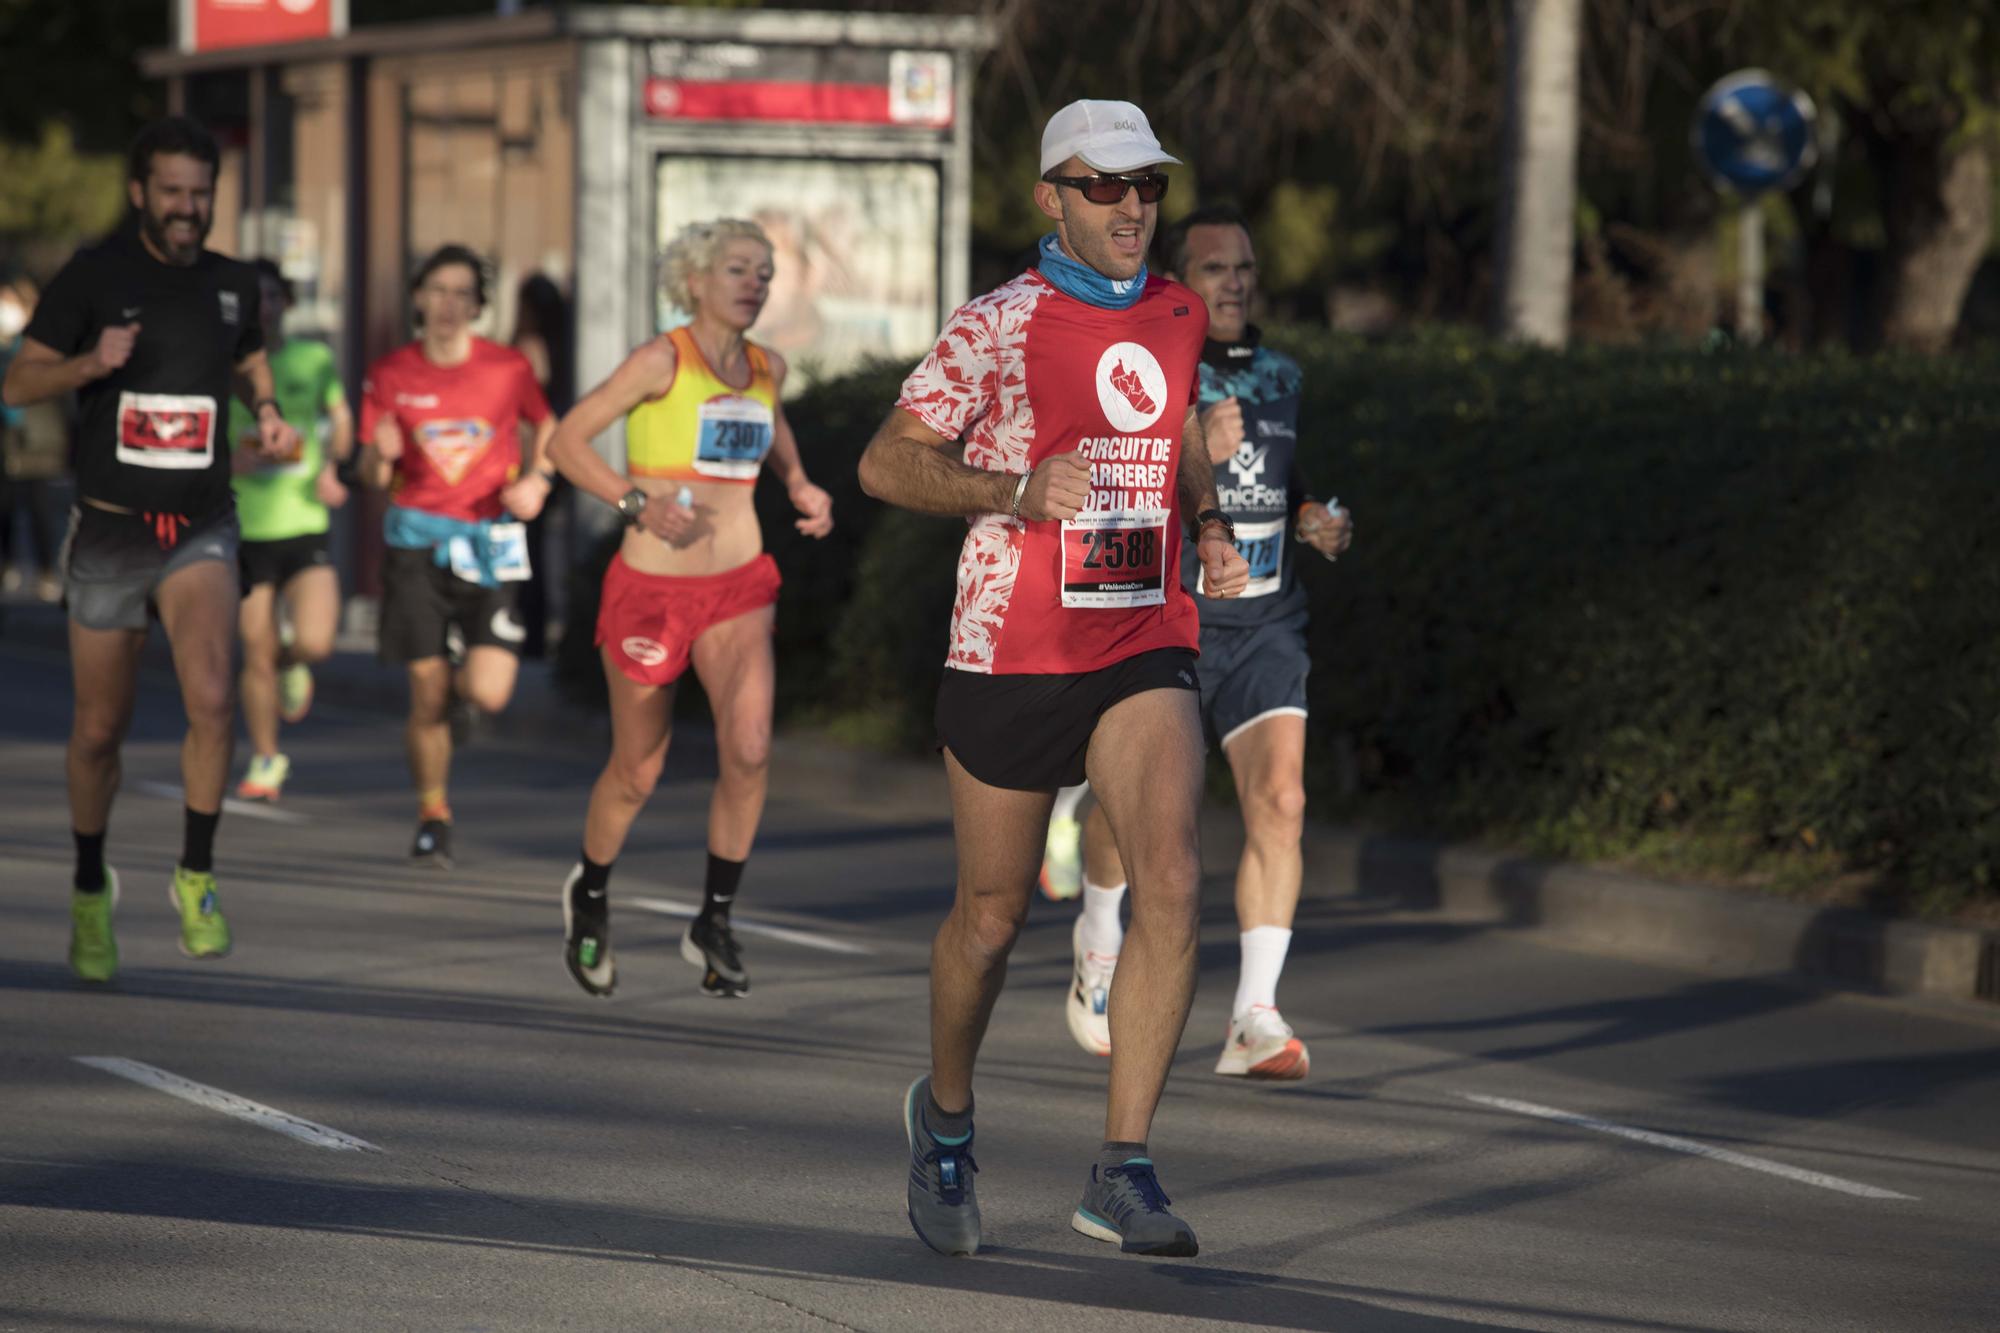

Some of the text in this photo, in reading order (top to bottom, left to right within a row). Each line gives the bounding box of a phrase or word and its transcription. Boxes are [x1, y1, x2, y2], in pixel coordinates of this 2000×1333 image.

[714, 420, 763, 450] 2301
[1077, 436, 1172, 462] CIRCUIT DE
[1088, 462, 1167, 488] ARRERES
[1082, 489, 1163, 512] OPULARS
[1081, 529, 1155, 570] 2588
